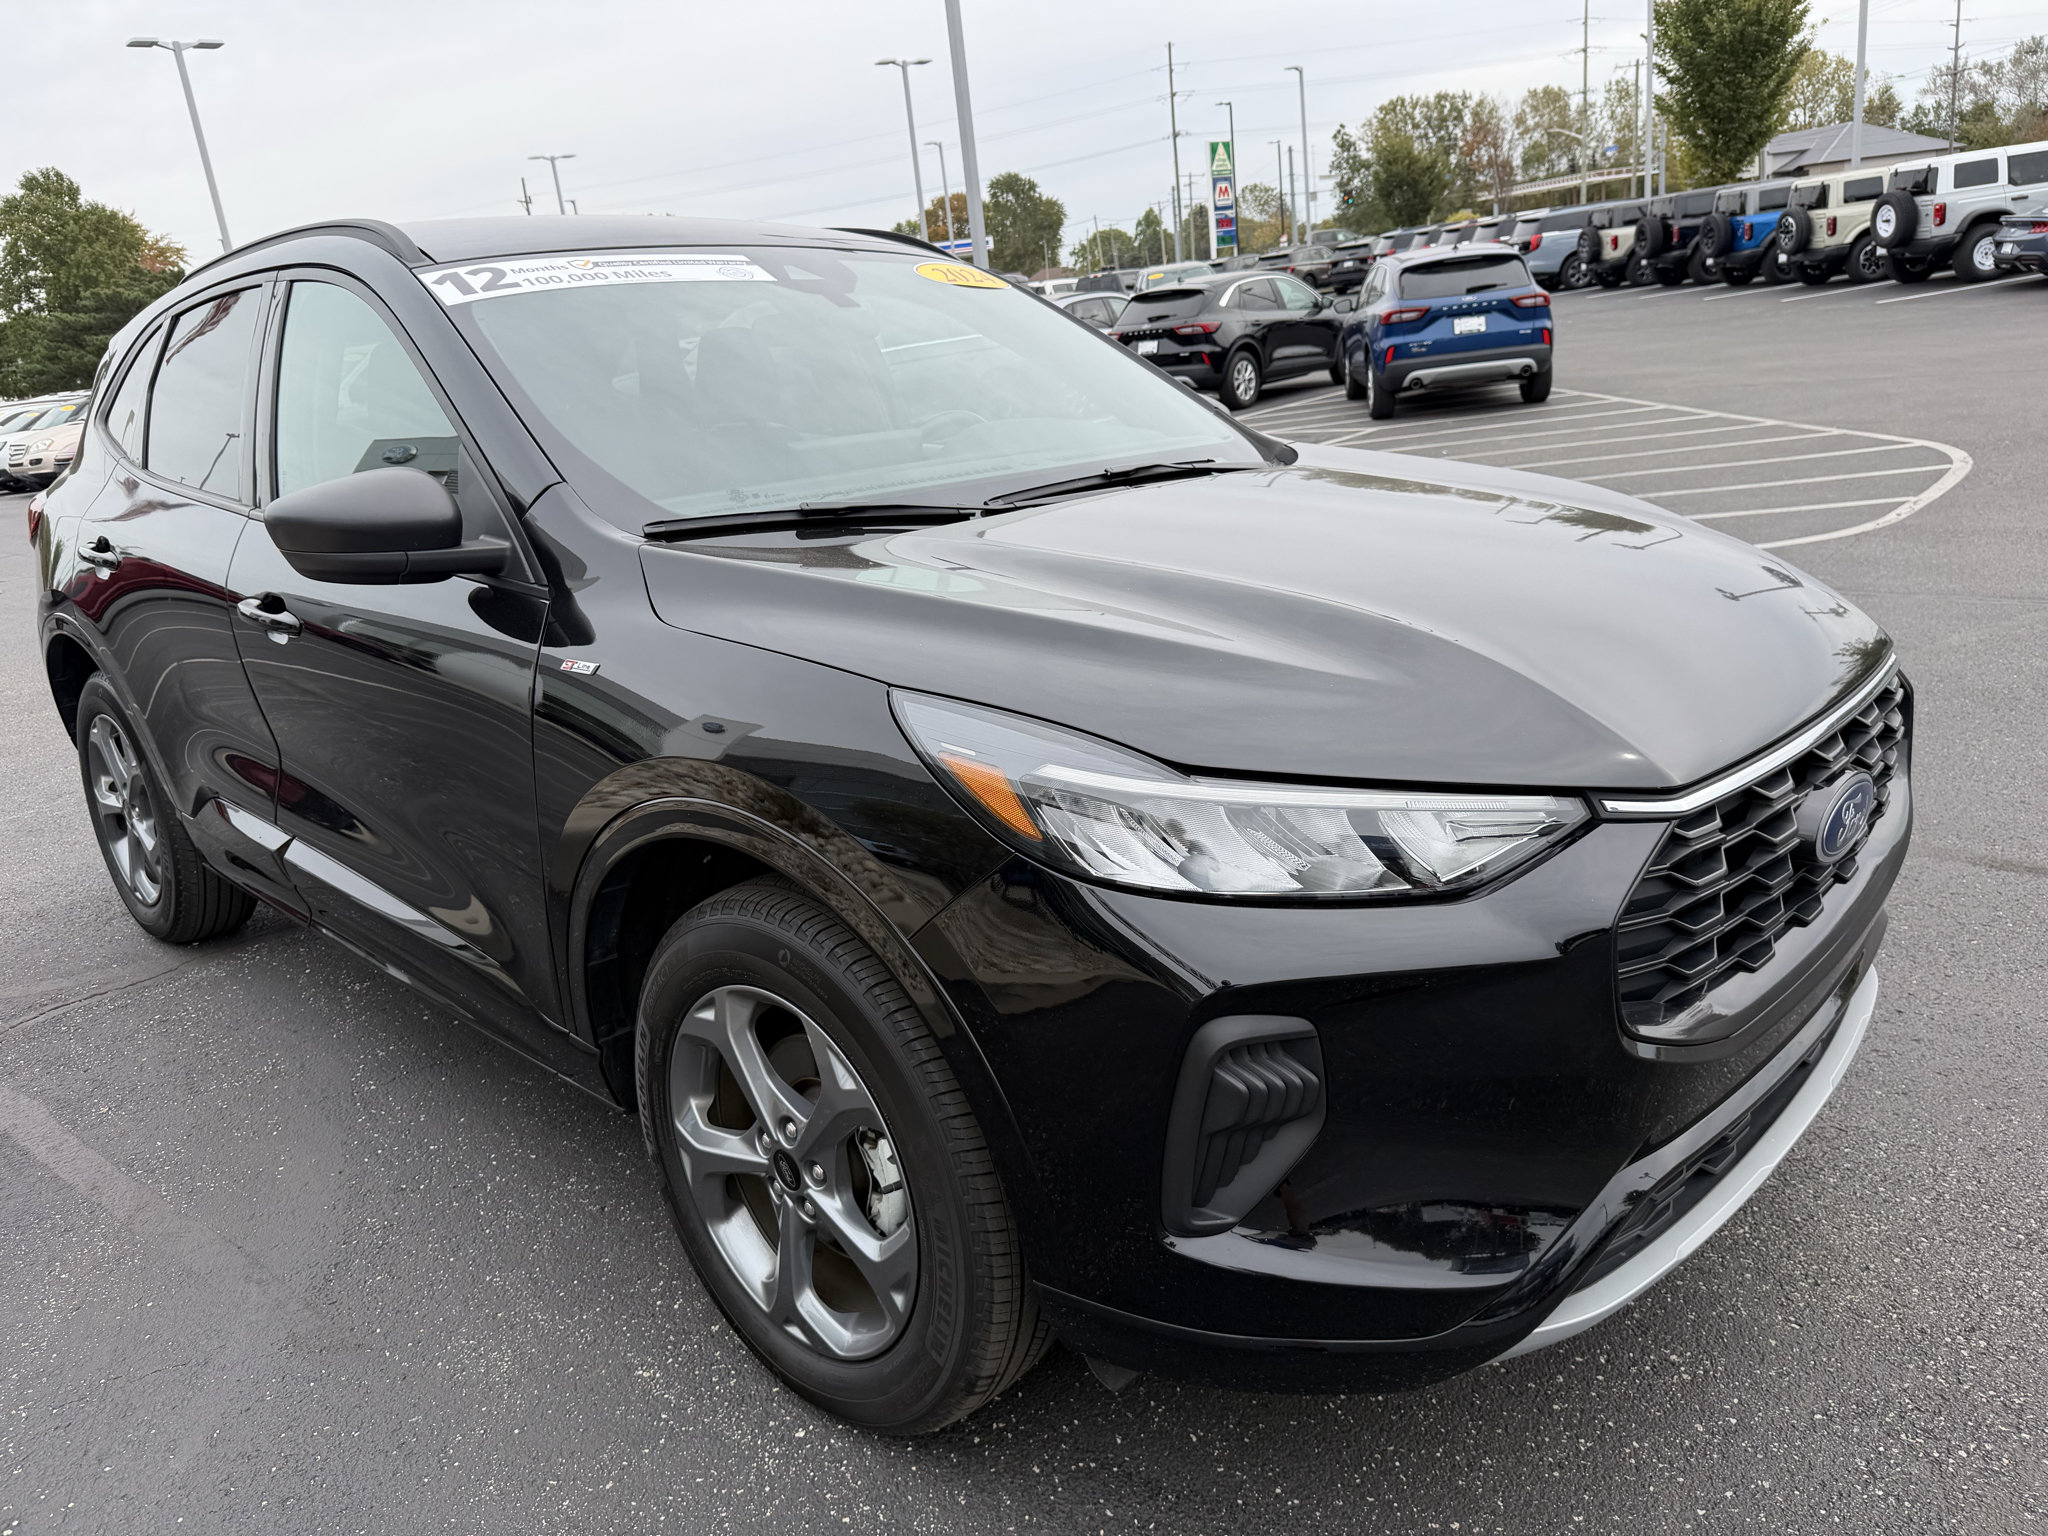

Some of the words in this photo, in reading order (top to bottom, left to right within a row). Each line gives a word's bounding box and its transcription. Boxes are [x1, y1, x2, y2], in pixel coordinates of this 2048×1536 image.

[1217, 185, 1230, 199] M
[510, 262, 570, 275] Months
[932, 268, 997, 284] 2024
[431, 266, 523, 297] 12
[522, 271, 610, 287] 100,000
[612, 269, 673, 279] Miles
[637, 1025, 653, 1145] MICHELIN
[931, 1217, 954, 1360] MICHELIN
